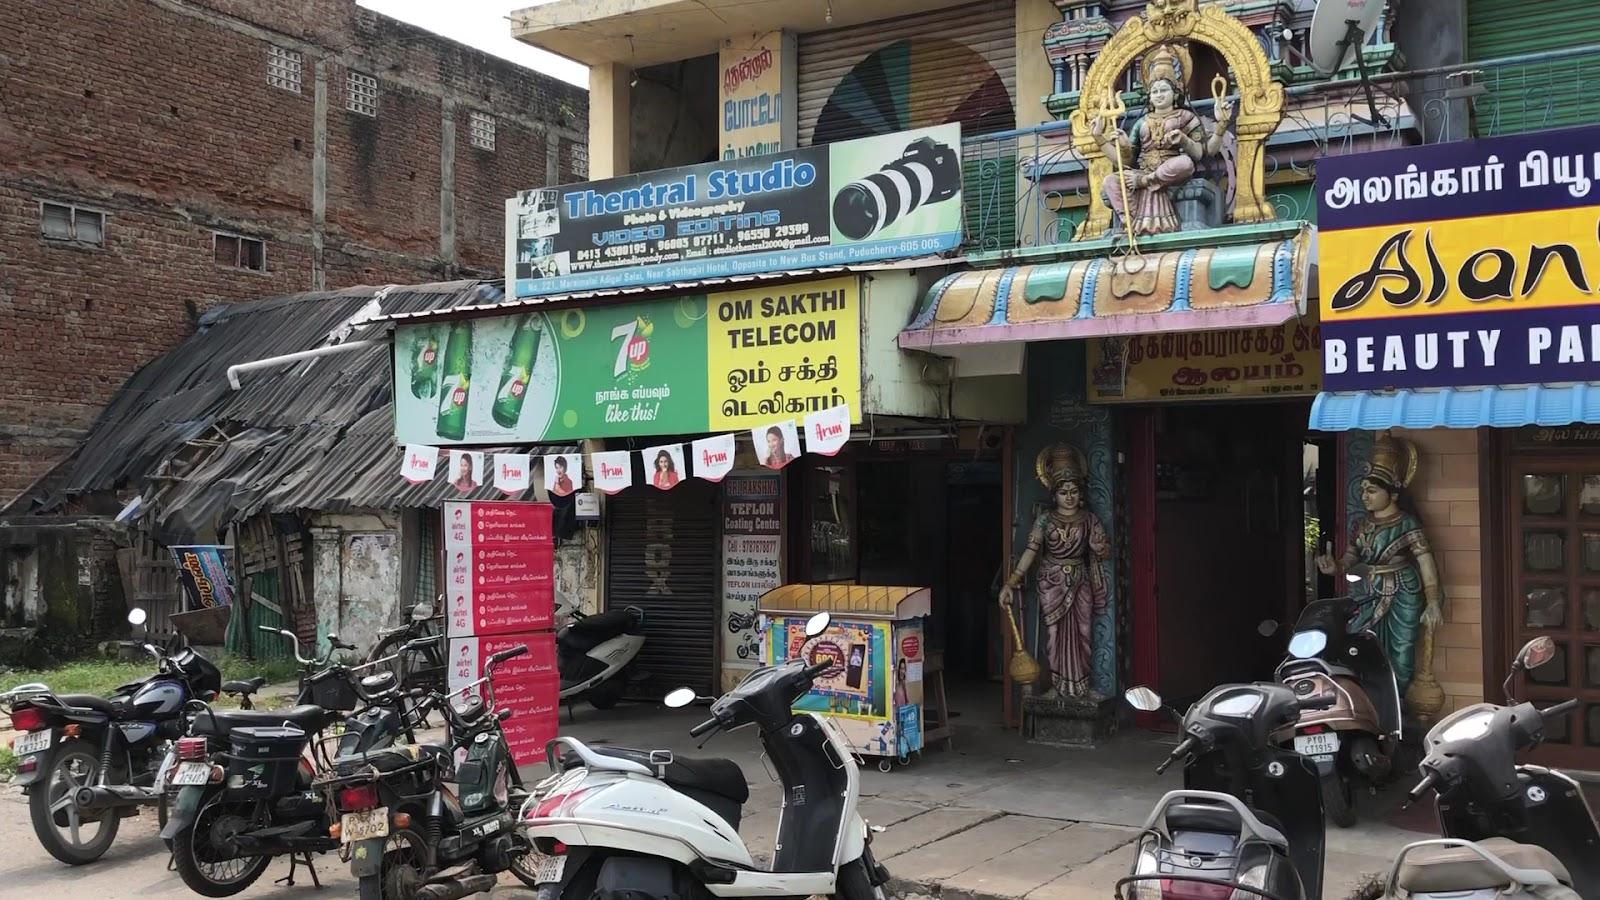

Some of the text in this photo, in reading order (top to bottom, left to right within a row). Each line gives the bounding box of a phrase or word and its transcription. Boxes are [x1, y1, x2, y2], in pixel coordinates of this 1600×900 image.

[564, 159, 817, 219] Thentral Studio
[1325, 150, 1600, 209] அலங்கார் பியூ
[623, 213, 657, 226] Photo
[769, 257, 778, 266] to
[780, 254, 799, 264] New
[801, 252, 817, 262] Bus
[1331, 218, 1600, 311] Alan
[719, 289, 846, 323] OM SAKTHI
[728, 319, 836, 349] TELECOM
[1325, 328, 1501, 375] BEAUTY
[727, 355, 838, 393] ஓம் சக்தி
[595, 386, 628, 405] நாங்க
[722, 386, 845, 417] டெலிகாம்
[605, 402, 660, 424] like this!
[731, 502, 774, 515] TEFLON
[725, 516, 780, 532] Coating Centre
[459, 669, 469, 678] 4G
[1305, 744, 1333, 754] CT1915
[1307, 735, 1327, 744] PY01
